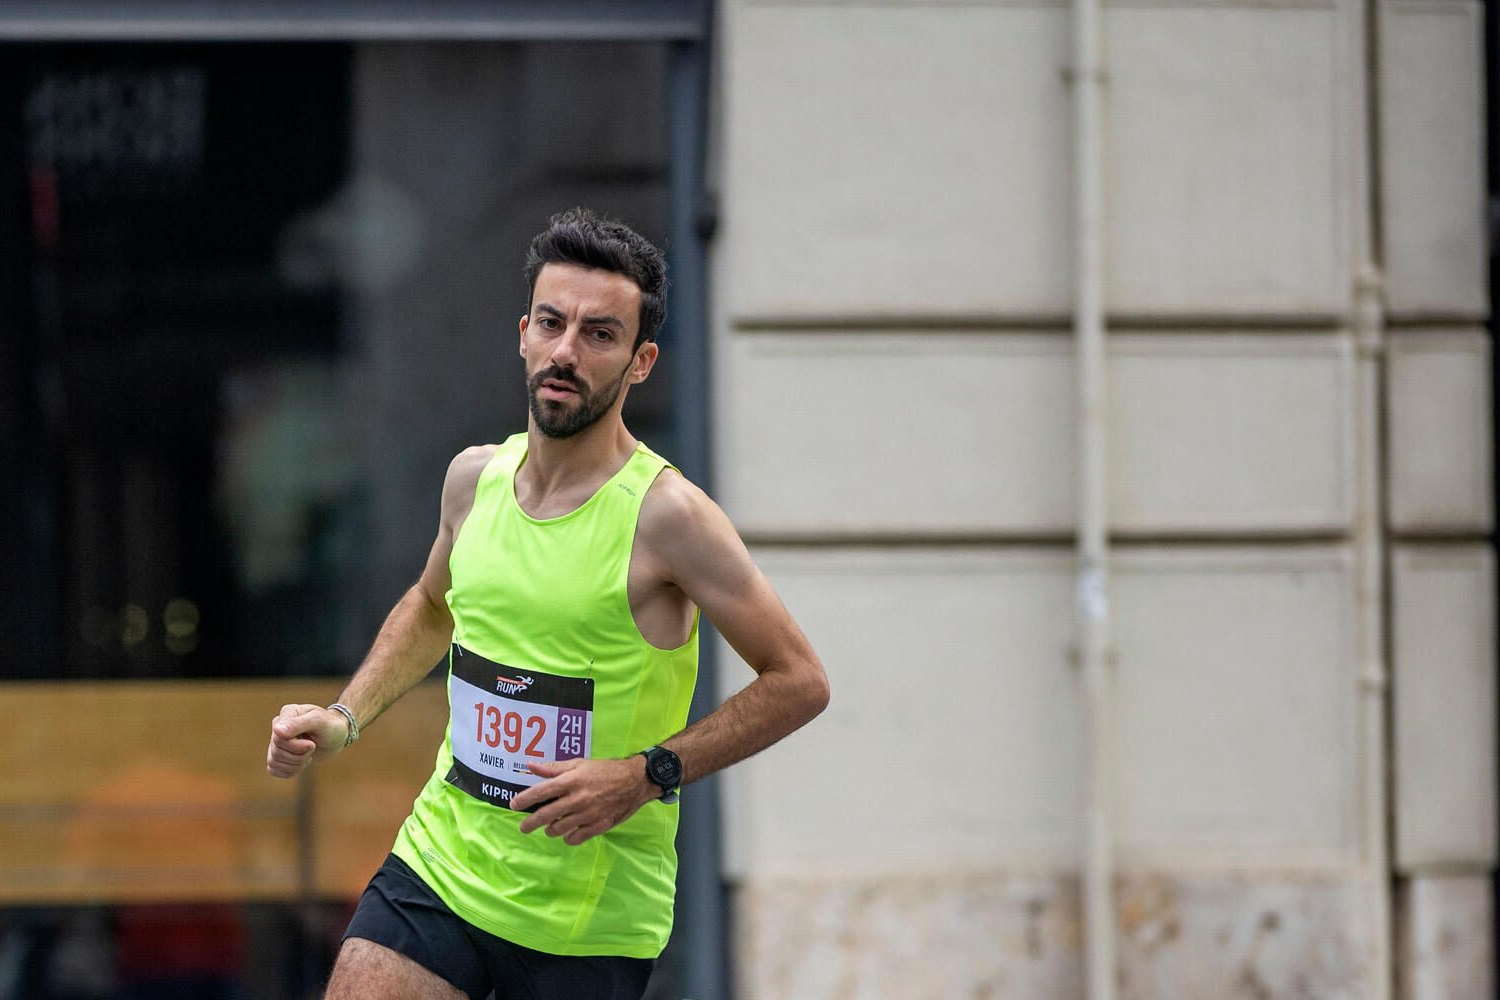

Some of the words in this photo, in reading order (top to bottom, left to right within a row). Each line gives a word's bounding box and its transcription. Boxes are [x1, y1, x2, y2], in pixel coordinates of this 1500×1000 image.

[496, 681, 516, 695] RUN
[475, 702, 547, 757] 1392
[560, 714, 582, 735] 2H
[559, 735, 581, 755] 45
[479, 752, 505, 769] XAVIER
[481, 782, 518, 801] KIPRU
